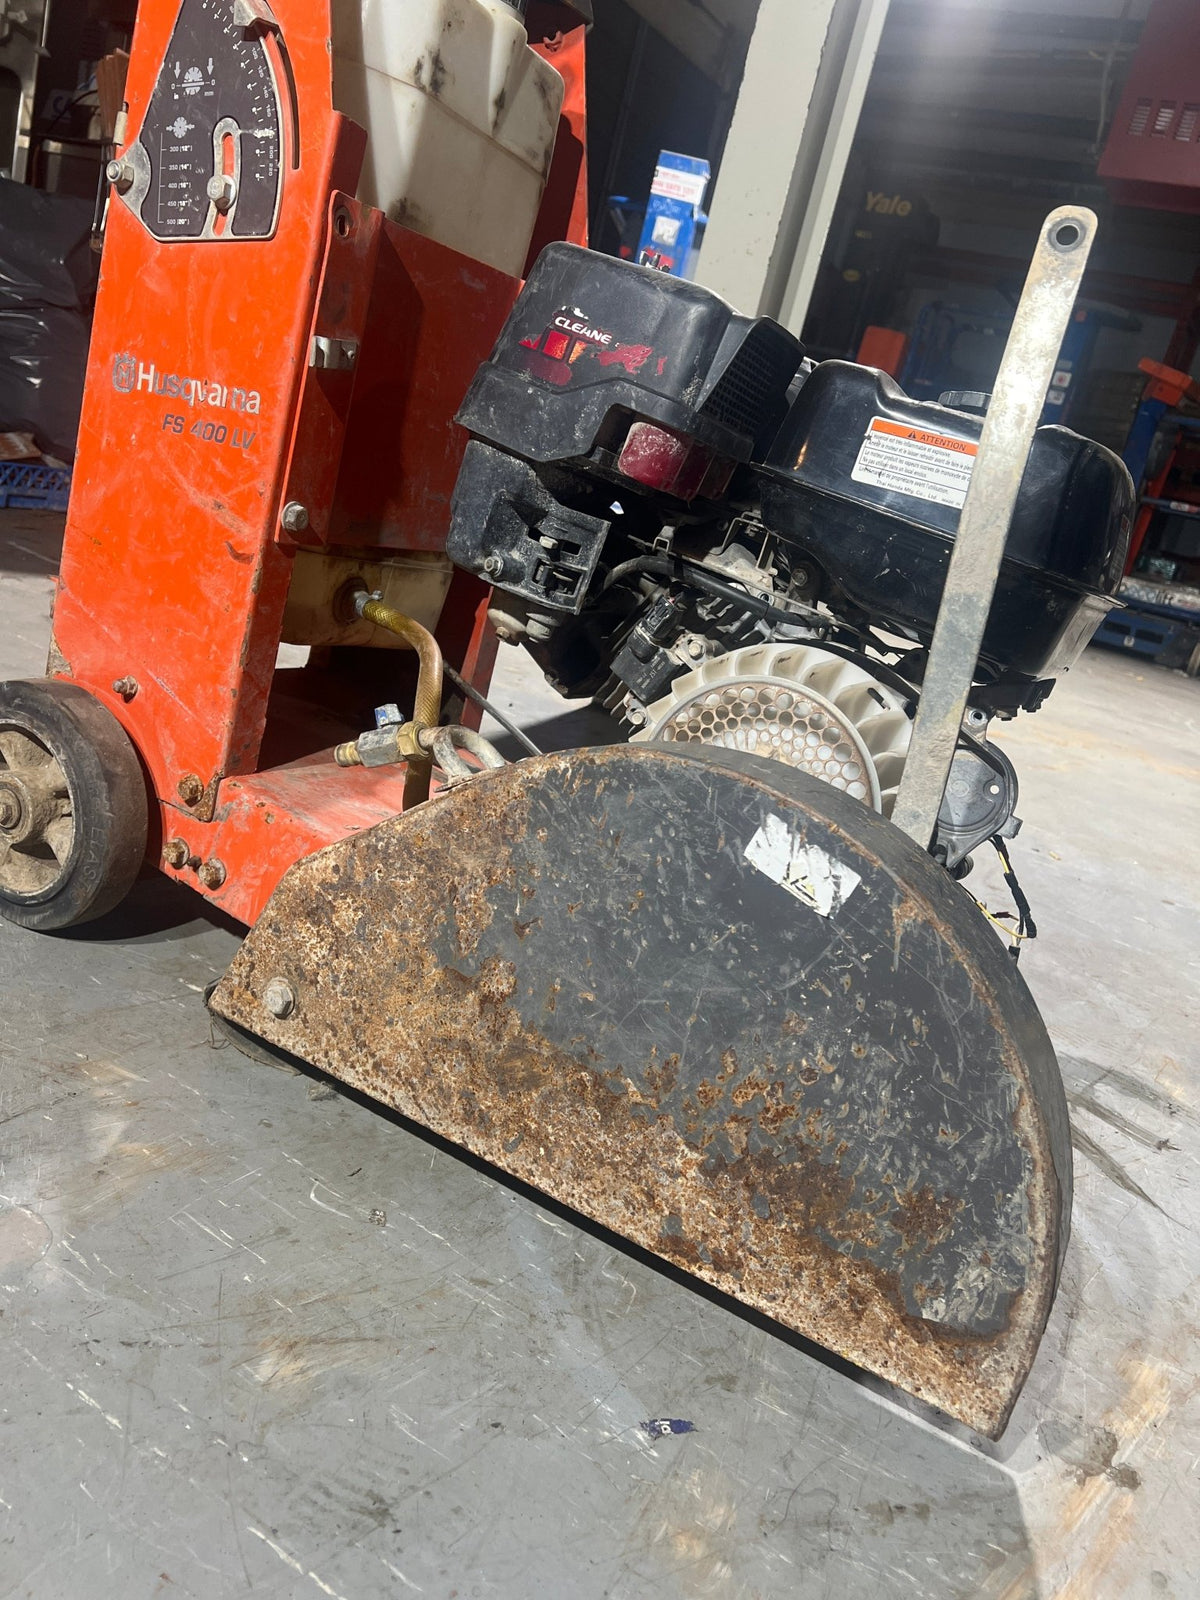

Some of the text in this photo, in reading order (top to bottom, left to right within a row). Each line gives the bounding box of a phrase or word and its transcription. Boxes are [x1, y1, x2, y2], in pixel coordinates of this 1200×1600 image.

[866, 191, 912, 216] Yale
[137, 362, 261, 415] Husqvarna
[162, 413, 257, 449] FS 400 LV
[919, 433, 966, 451] ATTENTION
